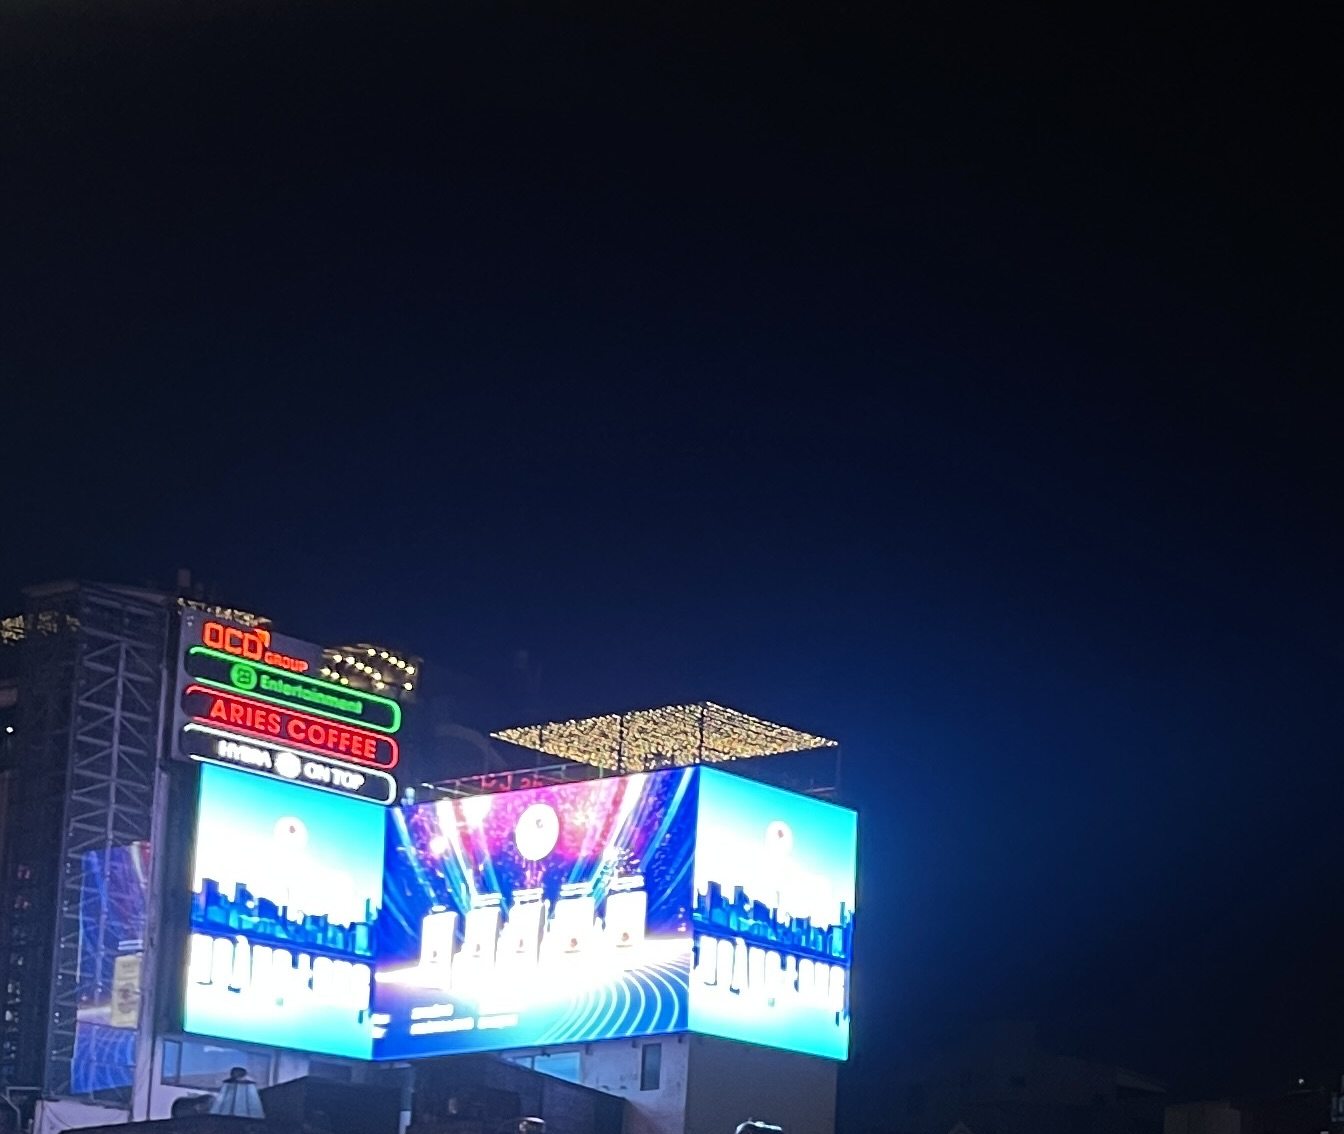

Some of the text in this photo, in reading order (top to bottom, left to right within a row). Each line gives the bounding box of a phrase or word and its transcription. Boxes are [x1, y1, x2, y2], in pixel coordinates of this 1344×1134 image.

[203, 621, 309, 673] OCD GROUP
[259, 674, 363, 715] Entertainment
[209, 699, 378, 759] ARIES COFFEE
[303, 762, 331, 783] ON
[331, 768, 366, 791] TOP
